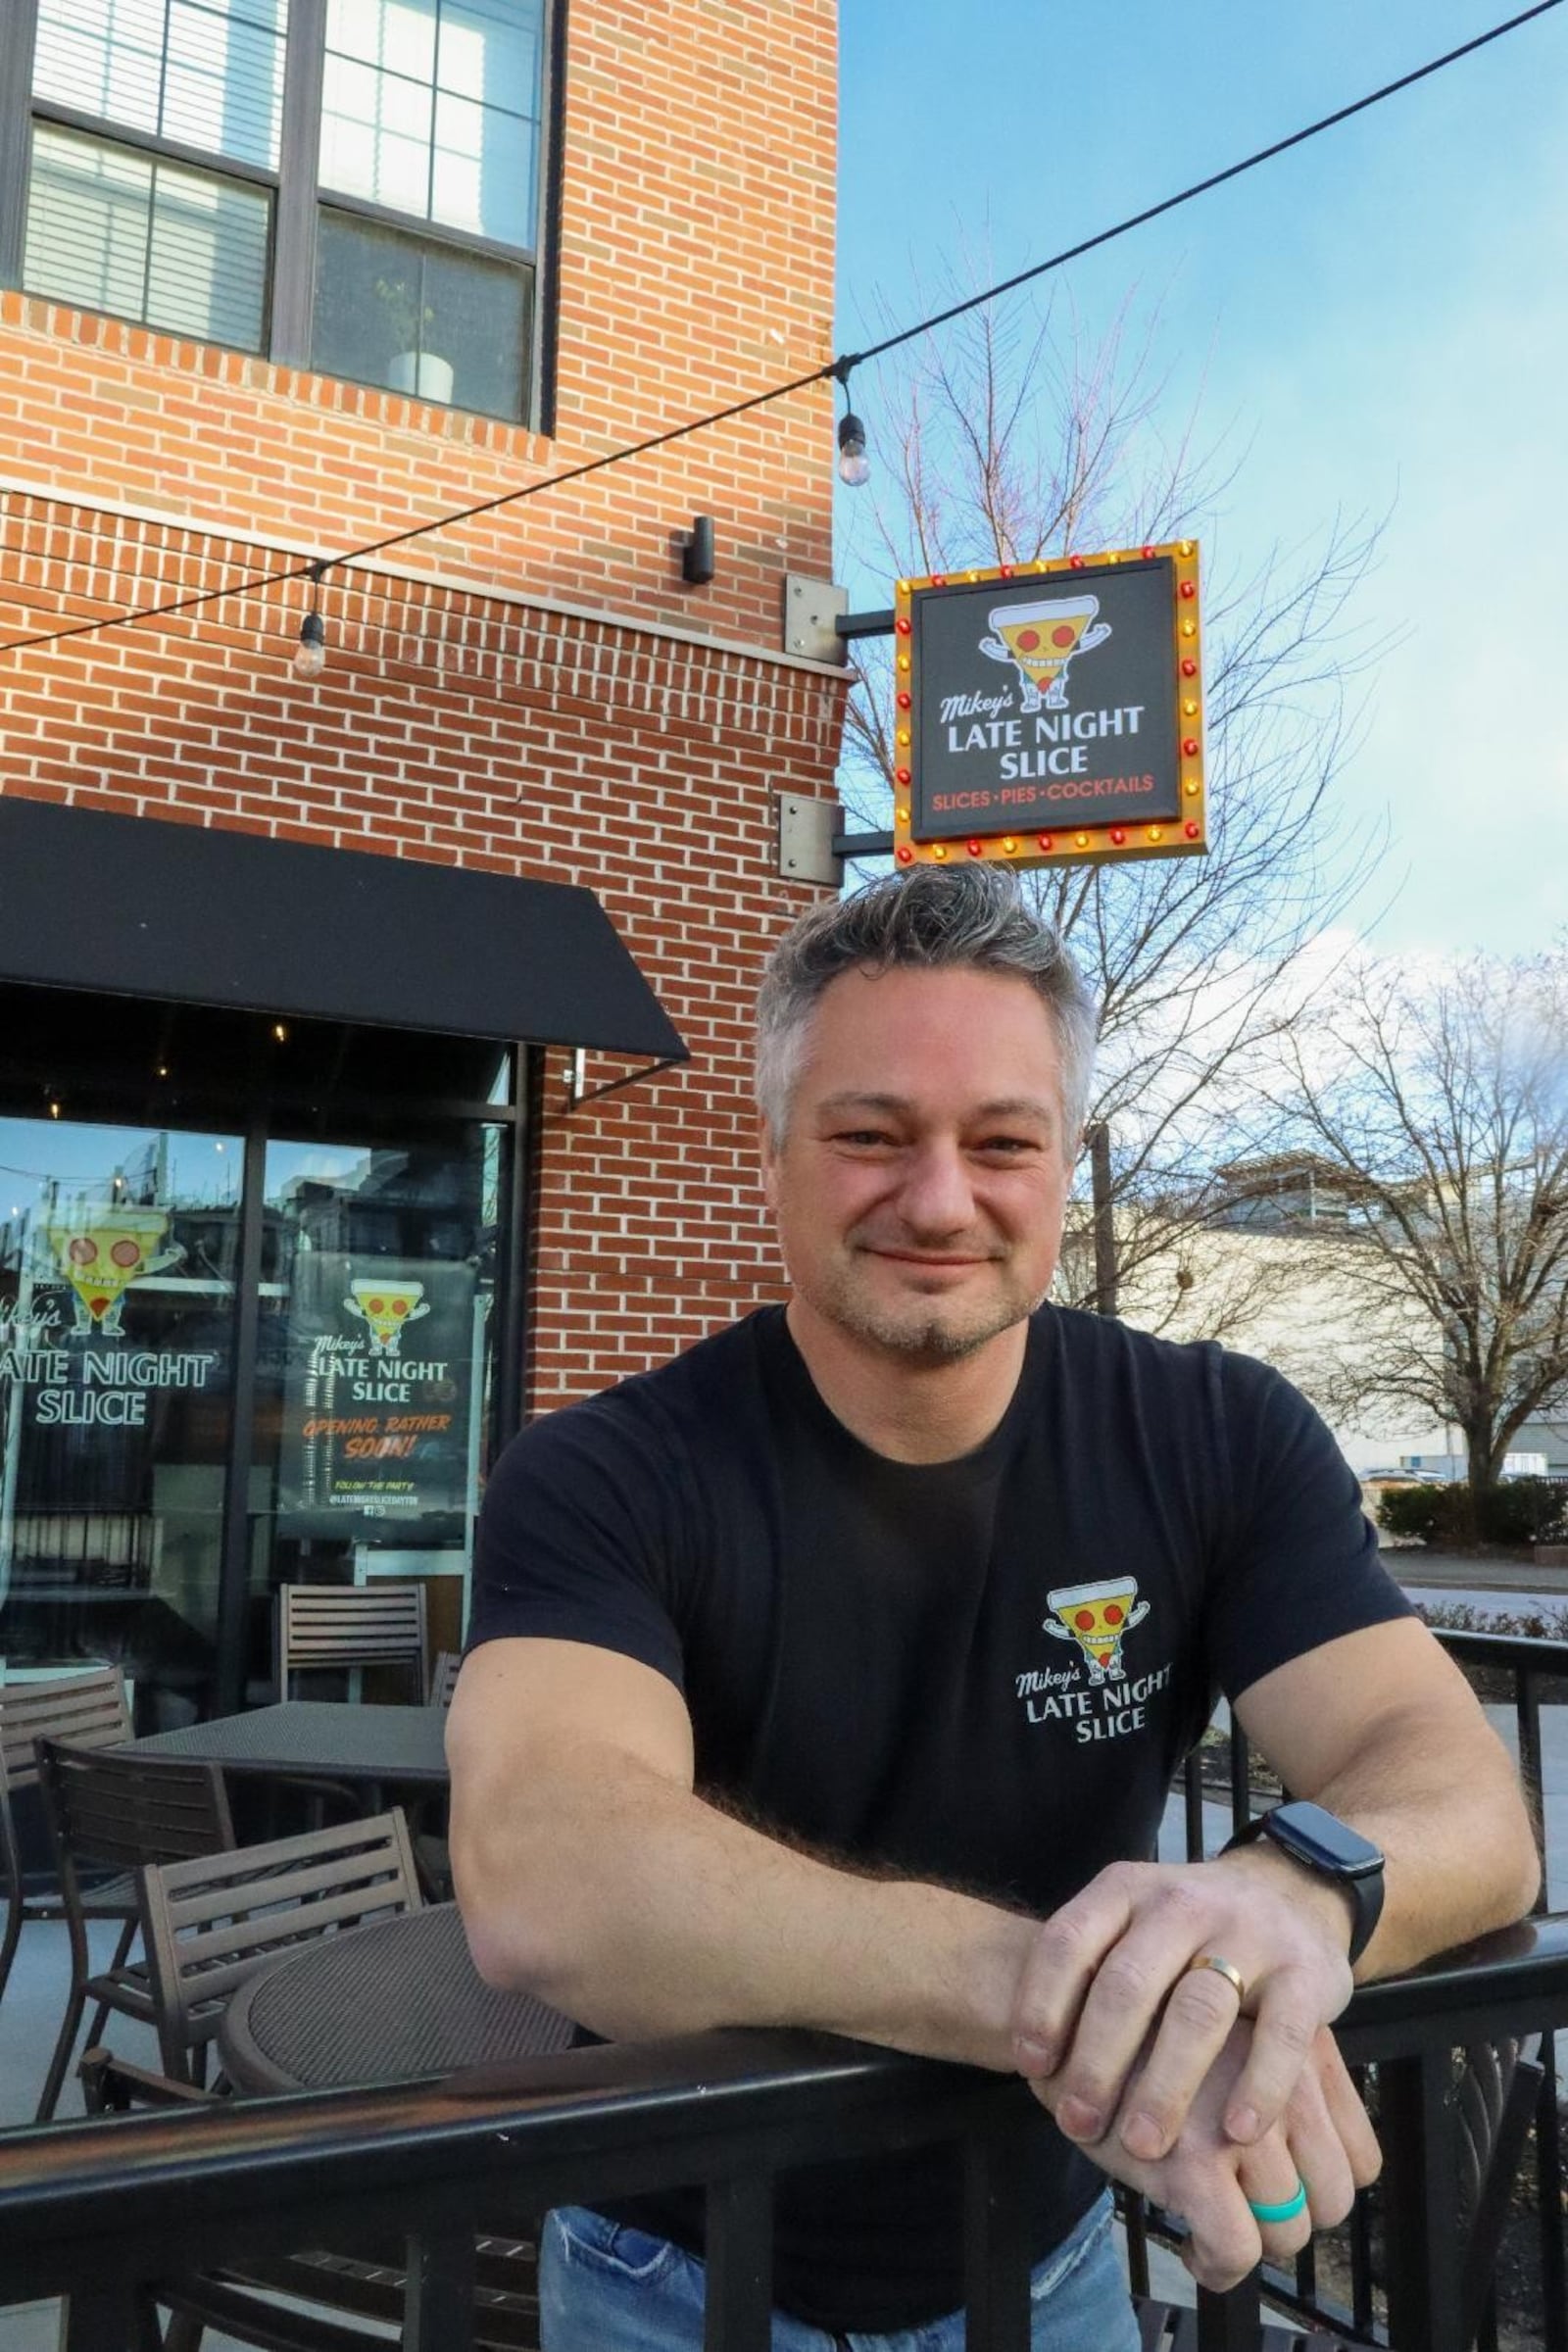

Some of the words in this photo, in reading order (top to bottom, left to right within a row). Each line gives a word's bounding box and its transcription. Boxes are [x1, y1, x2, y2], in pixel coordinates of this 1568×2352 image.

[940, 685, 1013, 723] Mikey's
[948, 718, 1022, 753] LATE
[1035, 706, 1145, 744] NIGHT
[1000, 746, 1089, 780] SLICE
[932, 791, 990, 811] SLICES
[1001, 786, 1036, 806] PIES
[1046, 774, 1155, 800] COCKTAILS
[0, 1295, 62, 1329] ikey's
[314, 1333, 366, 1356] Mikey's
[0, 1348, 70, 1384] ATE
[82, 1350, 214, 1387] NIGHT
[318, 1357, 369, 1378] LATE
[376, 1360, 448, 1382] NIGHT
[35, 1390, 147, 1425] SLICE
[352, 1382, 411, 1402] SLICE
[302, 1417, 378, 1437] OPENING
[385, 1414, 452, 1432] RATHER
[345, 1434, 417, 1458] SOON!
[1015, 1660, 1081, 1698] Mikey's
[1026, 1691, 1093, 1723] LATE
[1102, 1662, 1173, 1711] NIGHT
[1076, 1706, 1146, 1743] SLICE
